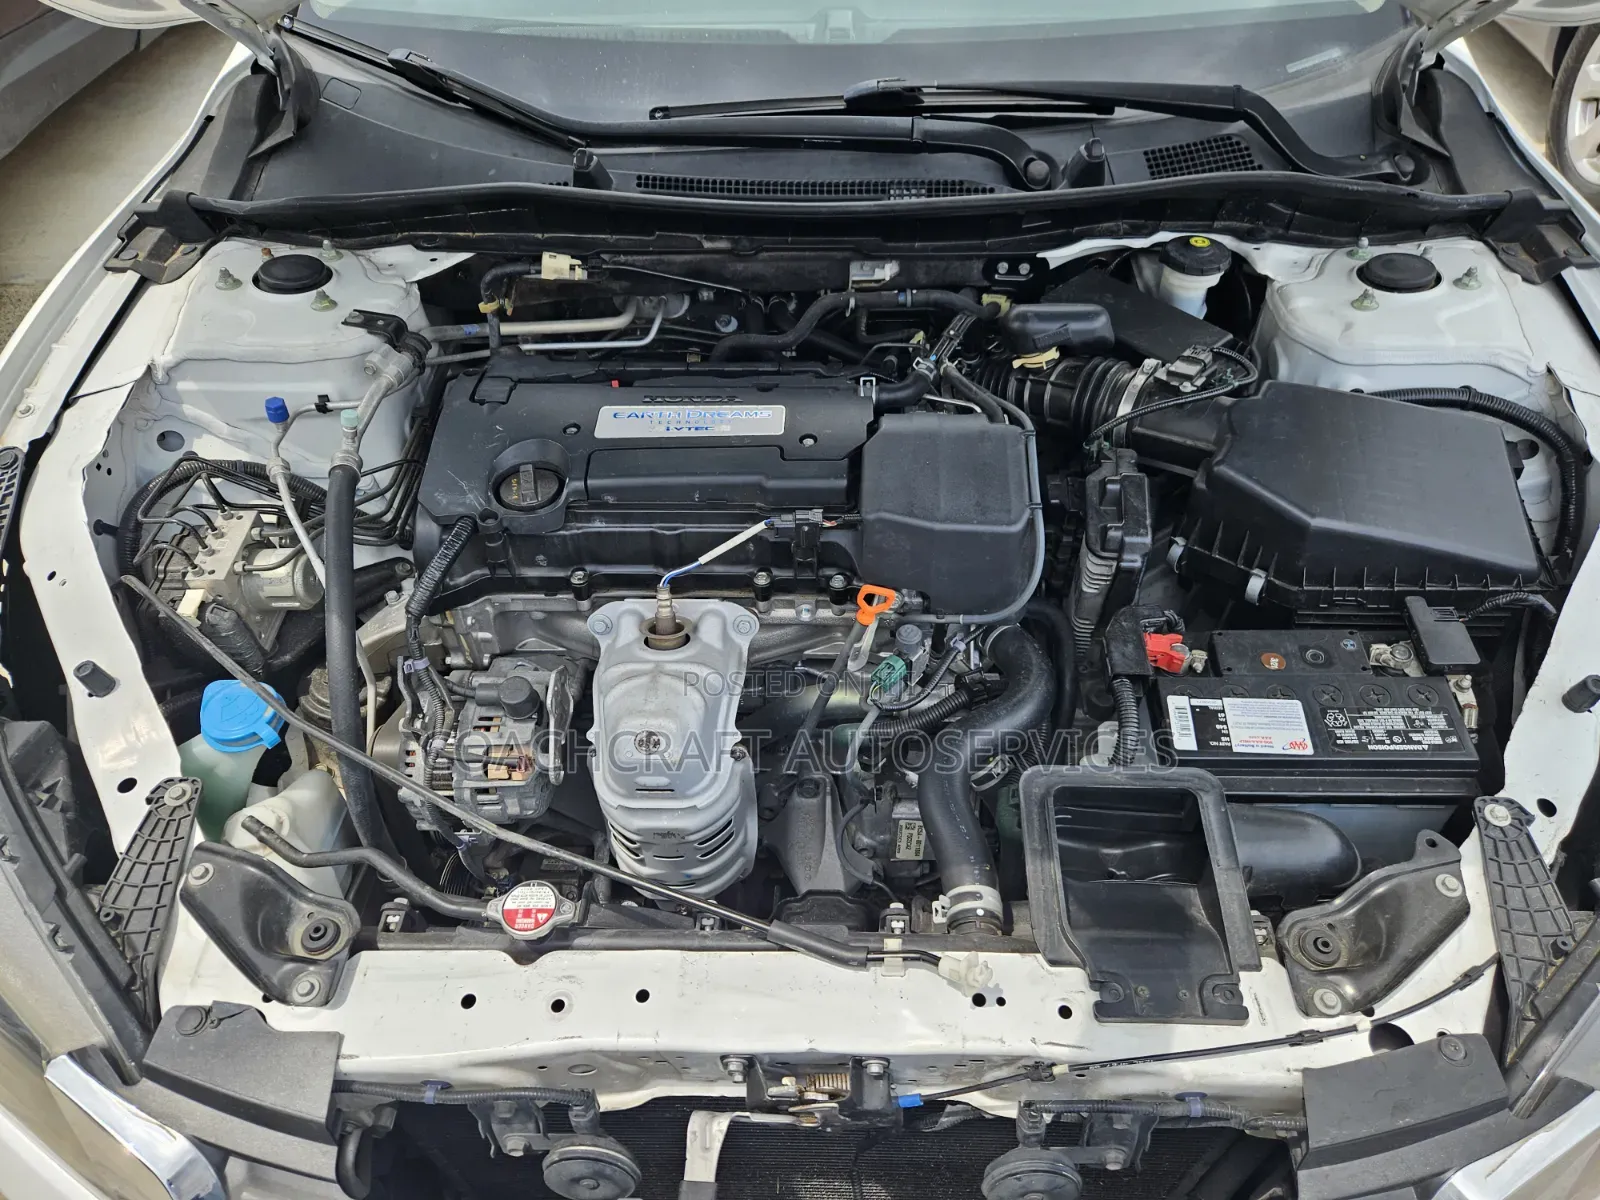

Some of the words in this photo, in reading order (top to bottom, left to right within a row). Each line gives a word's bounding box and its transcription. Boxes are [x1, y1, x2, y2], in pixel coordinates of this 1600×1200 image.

[642, 395, 743, 403] HONDA
[613, 411, 682, 419] EARTH
[686, 410, 773, 419] DREAMS
